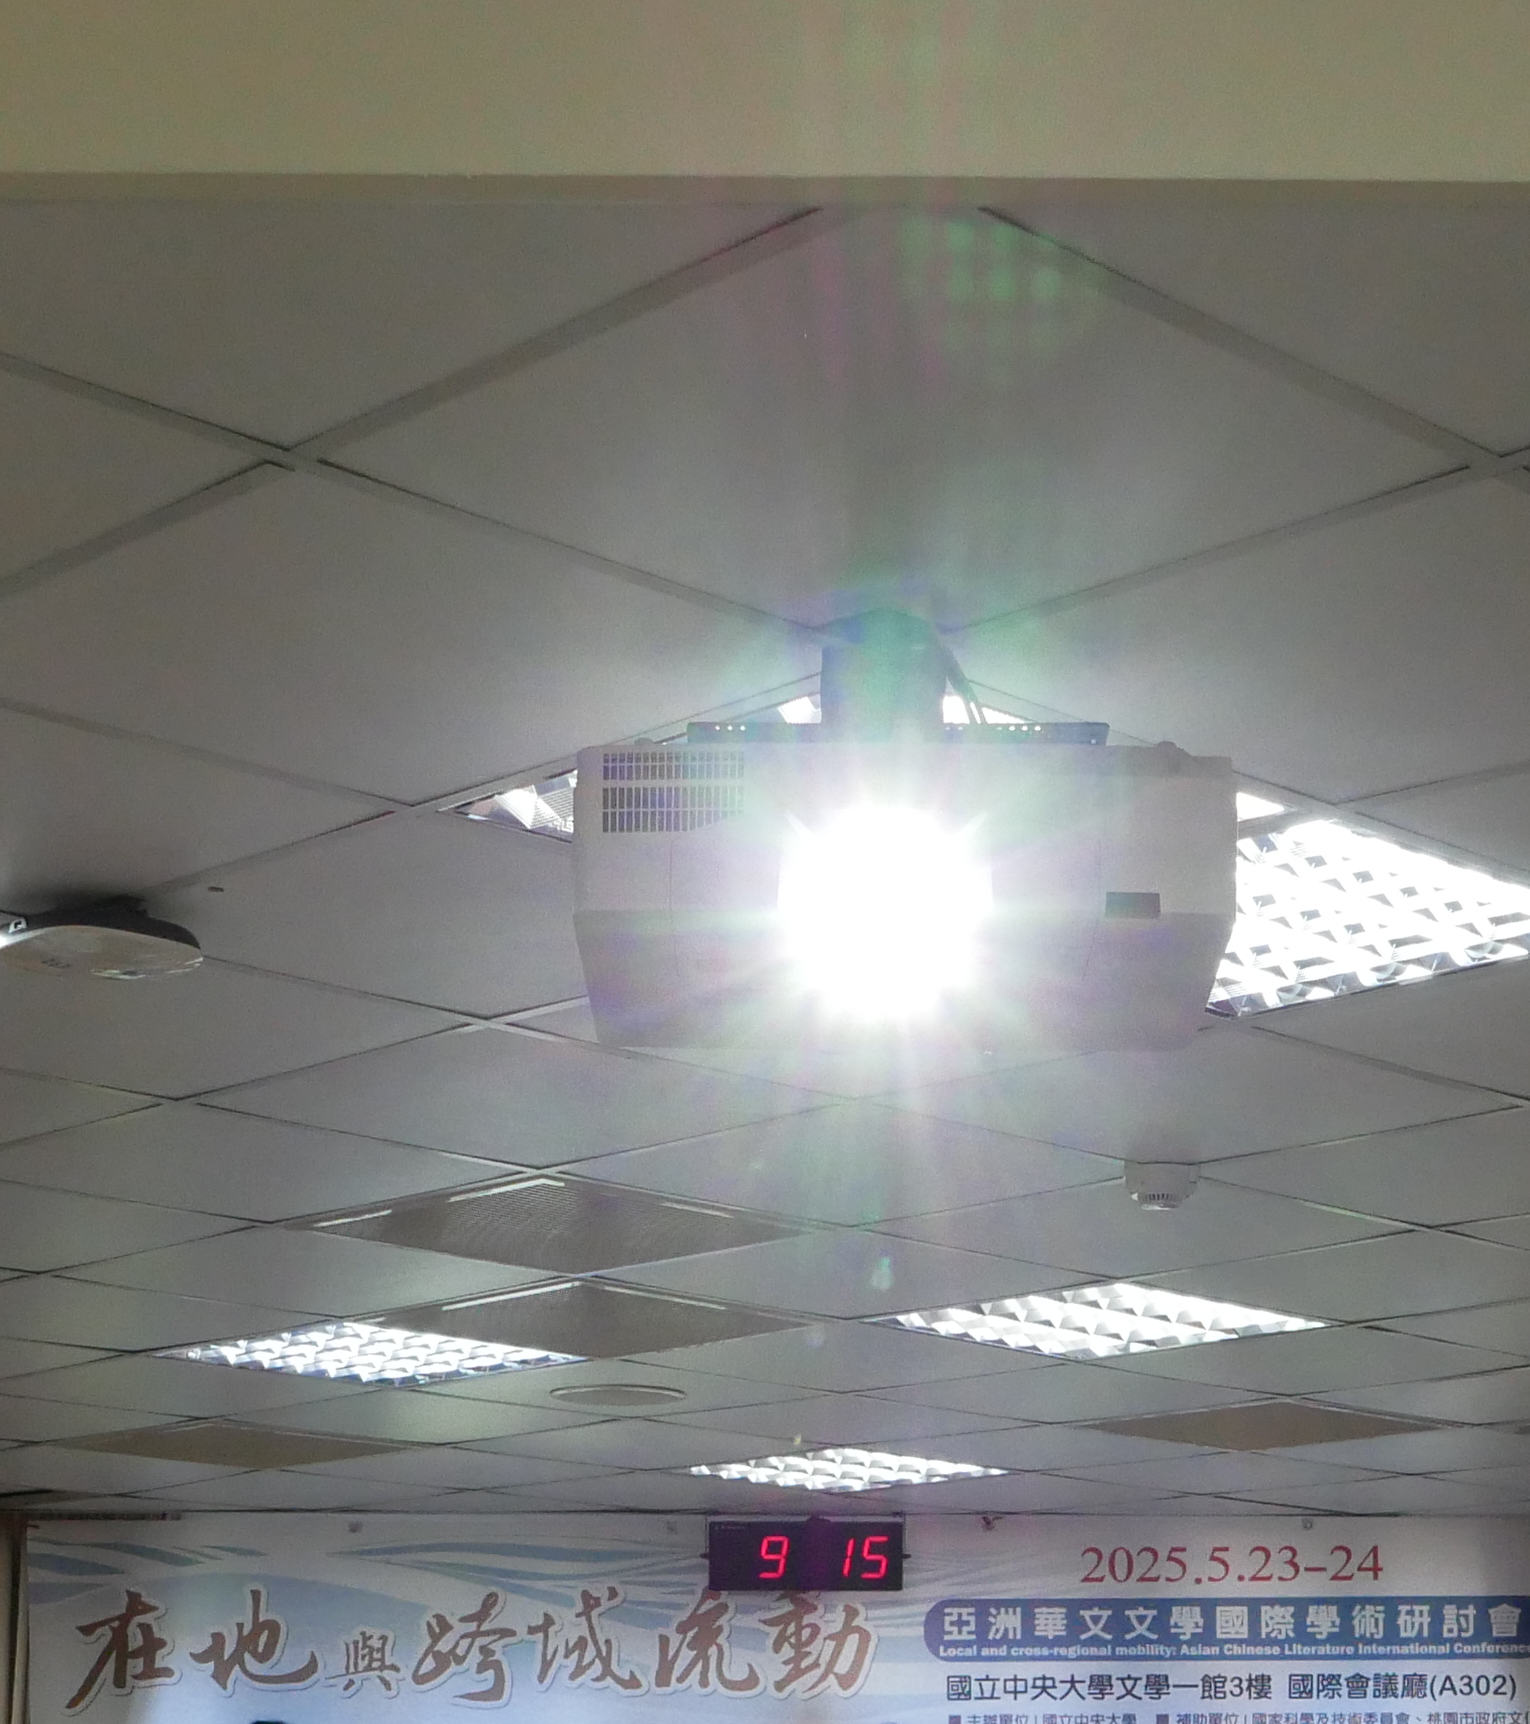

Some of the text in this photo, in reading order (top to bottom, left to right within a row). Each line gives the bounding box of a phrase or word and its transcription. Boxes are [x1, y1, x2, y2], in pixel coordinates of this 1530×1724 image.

[759, 1536, 889, 1579] 9 15
[1080, 1545, 1384, 1584] 2025.5.23-24
[943, 1603, 1522, 1640] 亞洲華文文學國際學術研討會
[66, 1586, 871, 1710] 在地與跨域流動
[939, 1645, 977, 1657] Local
[980, 1645, 1007, 1656] and
[1010, 1644, 1111, 1658] cross-regional
[1180, 1644, 1219, 1655] Asian
[1224, 1643, 1280, 1655] Chinese
[1284, 1643, 1354, 1655] Literature
[1358, 1642, 1449, 1654] International
[947, 1673, 1517, 1701] 國立中央大學文學一館3樓 國際會議廳(A302)
